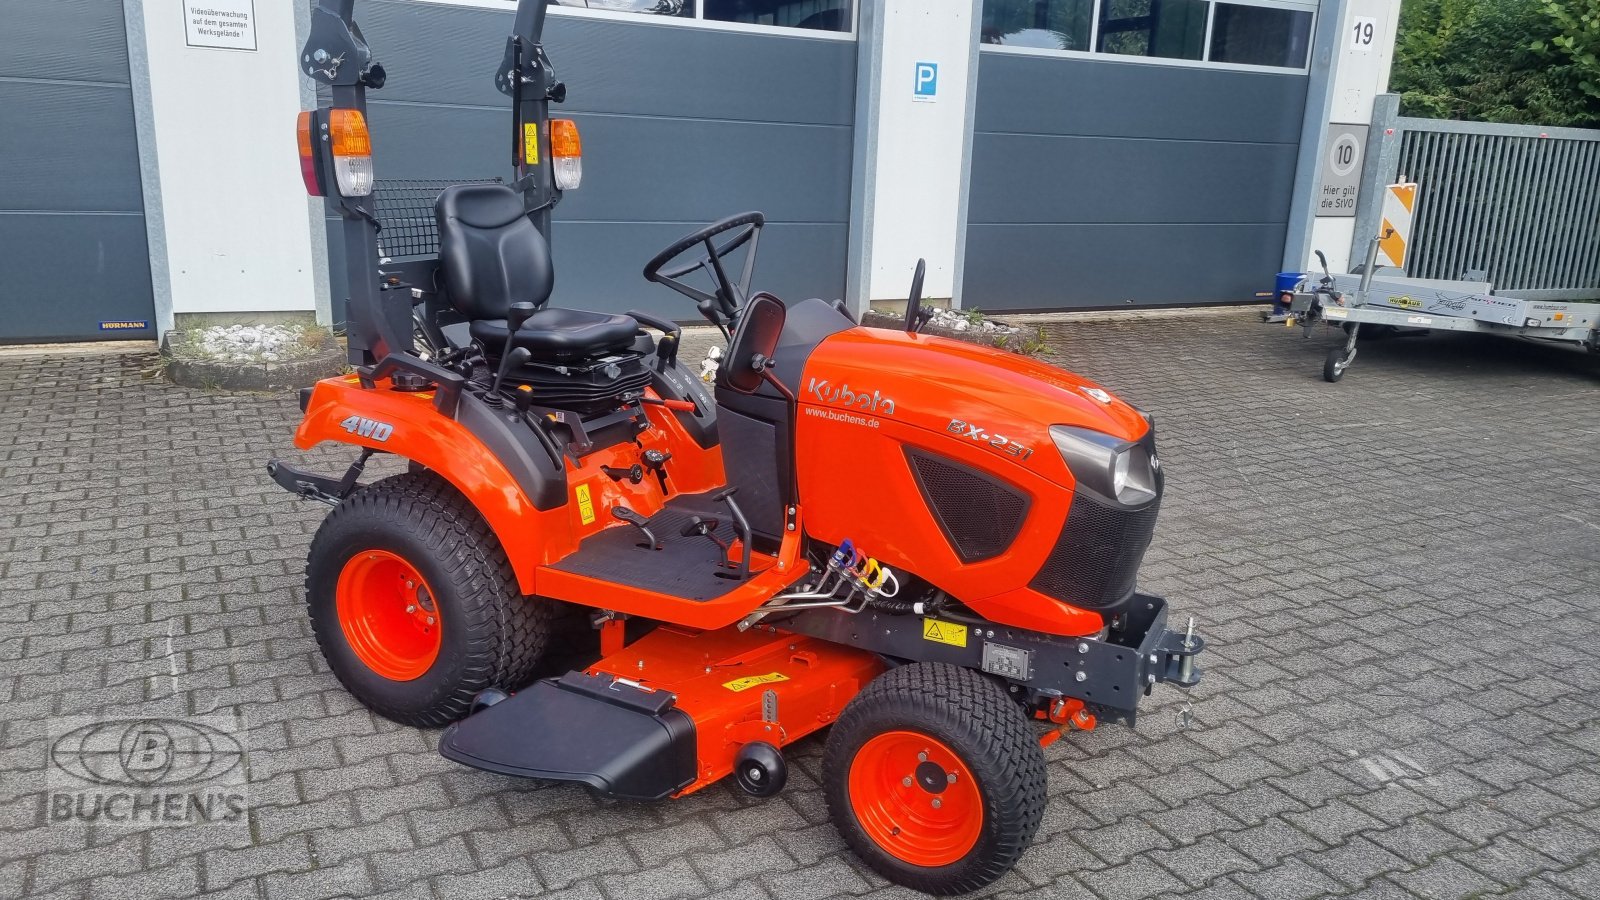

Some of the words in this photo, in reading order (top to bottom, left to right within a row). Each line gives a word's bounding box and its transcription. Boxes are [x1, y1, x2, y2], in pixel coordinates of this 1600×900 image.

[190, 7, 248, 20] Videoüberwachung
[204, 18, 217, 26] dem
[218, 20, 248, 28] gesamten
[197, 27, 240, 37] Werksgelände
[1353, 22, 1374, 45] 19
[917, 65, 935, 92] P
[1338, 144, 1353, 165] 10
[1323, 185, 1340, 195] Hier
[1342, 185, 1356, 197] gilt
[1321, 199, 1333, 208] die
[1335, 199, 1354, 208] StVO
[808, 377, 895, 415] Kubota
[339, 414, 394, 442] 4WD
[805, 407, 880, 428] www.buchens.de
